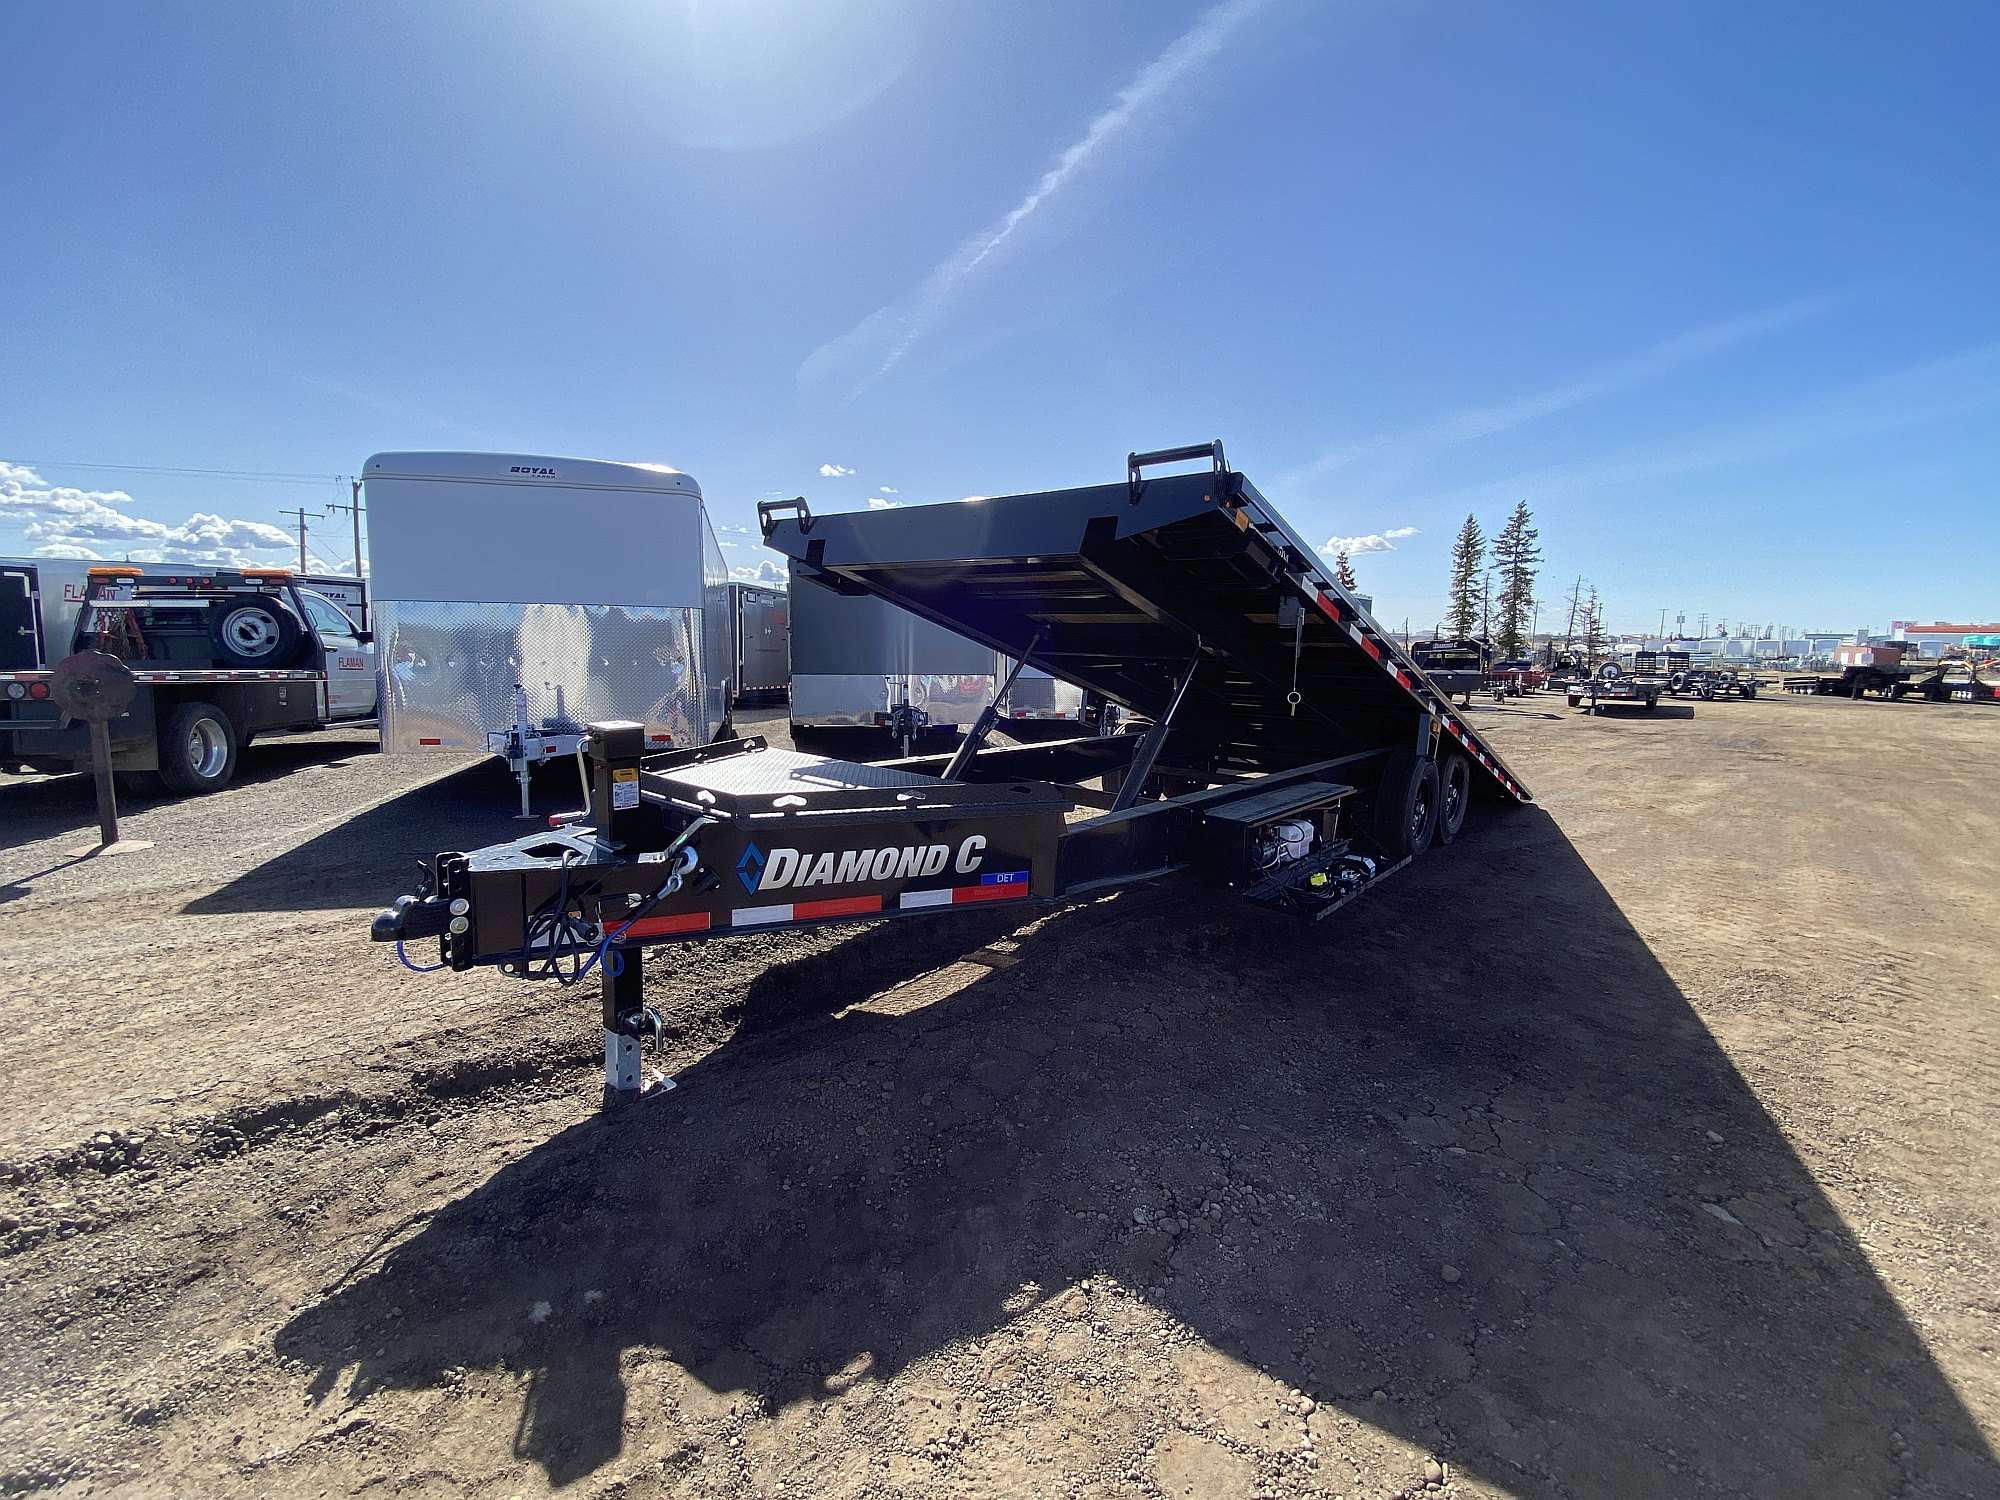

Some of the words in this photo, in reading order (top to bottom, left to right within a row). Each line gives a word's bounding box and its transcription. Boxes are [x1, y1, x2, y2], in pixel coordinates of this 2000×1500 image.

[511, 466, 555, 475] ROYAL
[64, 584, 116, 601] FLAAN
[338, 656, 364, 668] FLAMAN
[758, 844, 950, 891] DIAMOND
[955, 834, 987, 874] C
[997, 873, 1015, 883] DET
